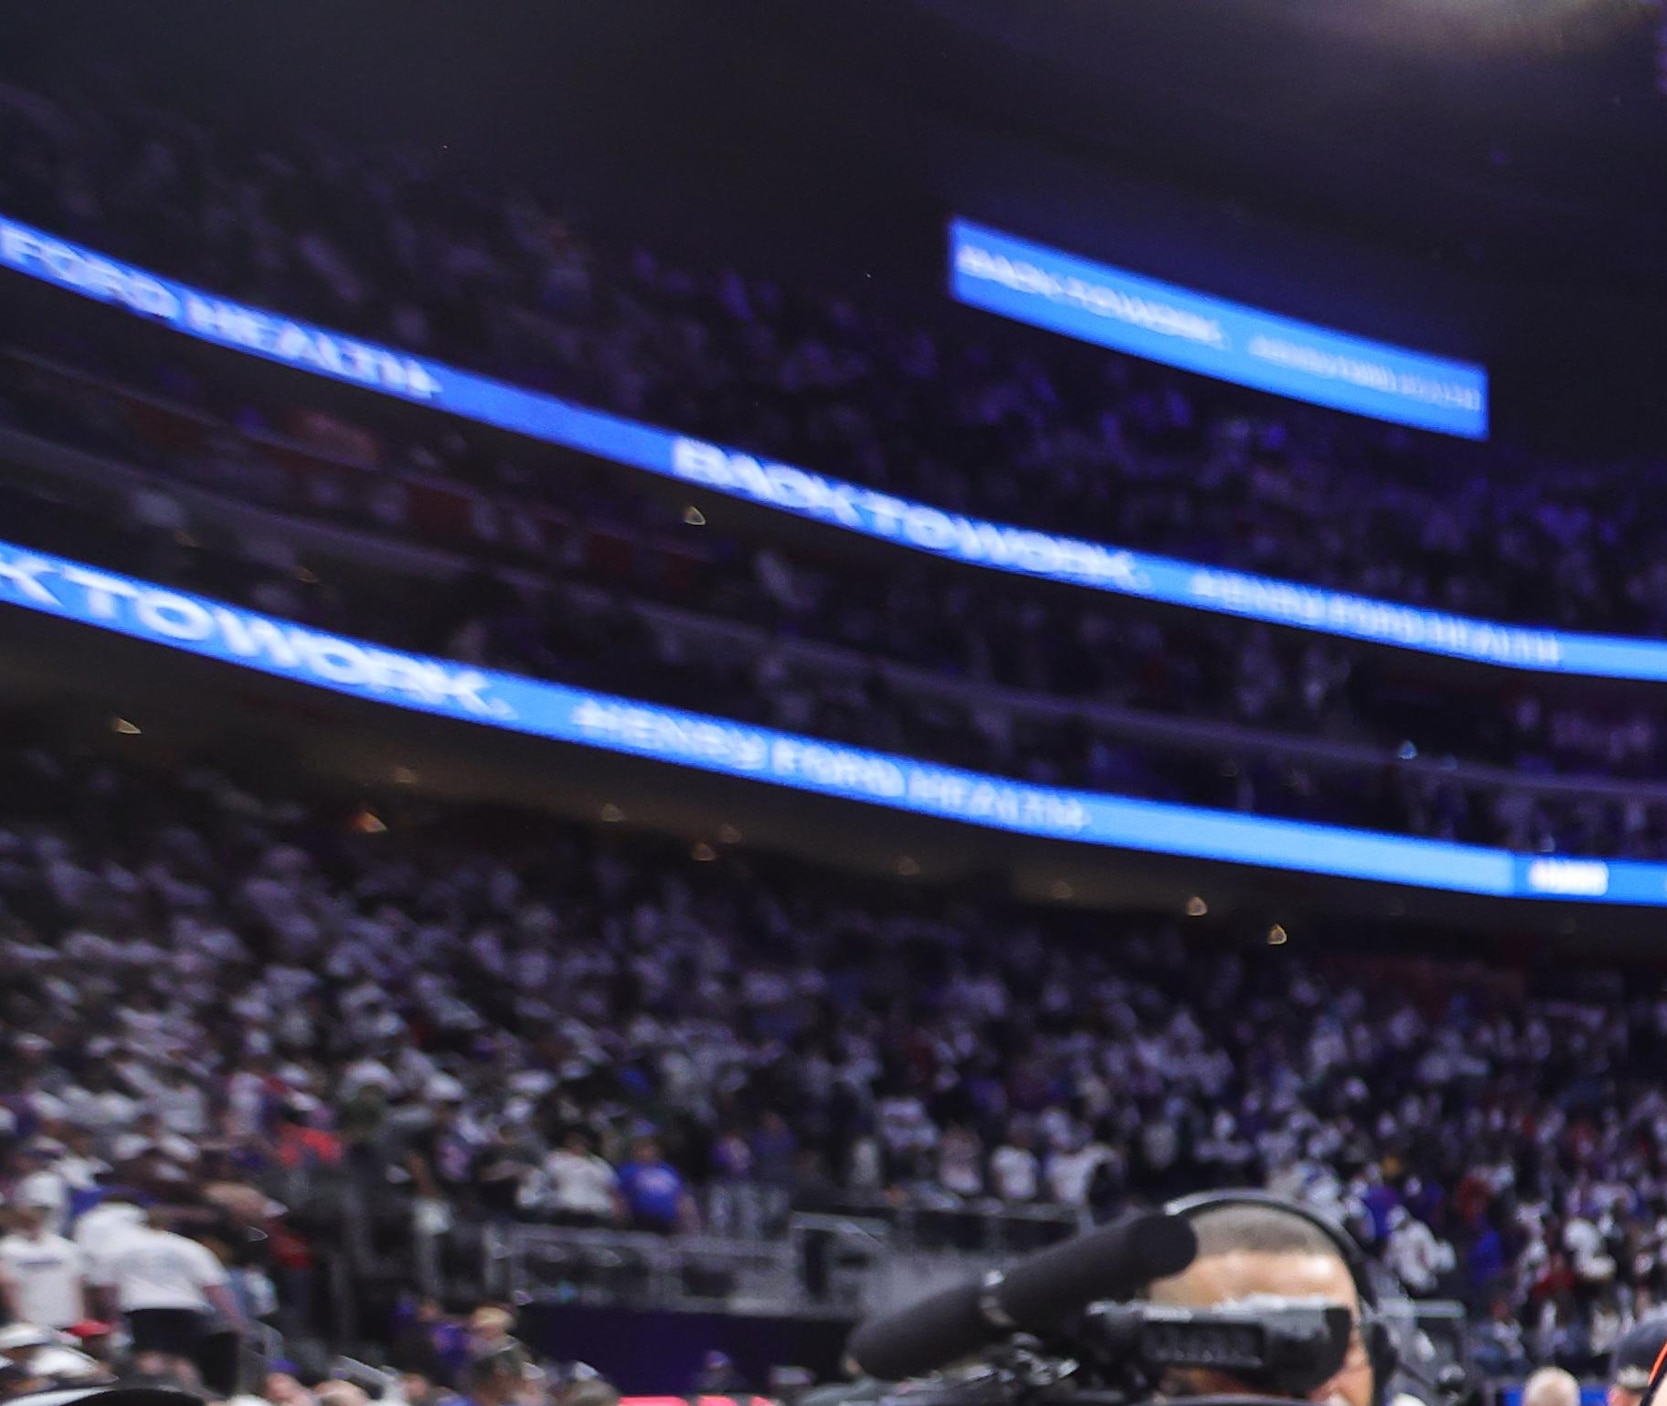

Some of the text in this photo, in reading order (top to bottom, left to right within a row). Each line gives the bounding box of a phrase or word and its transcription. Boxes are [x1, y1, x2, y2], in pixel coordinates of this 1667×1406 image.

[184, 294, 443, 400] HEALTH
[672, 435, 863, 528] BACK
[61, 562, 216, 642] TO
[212, 606, 498, 719] WORK
